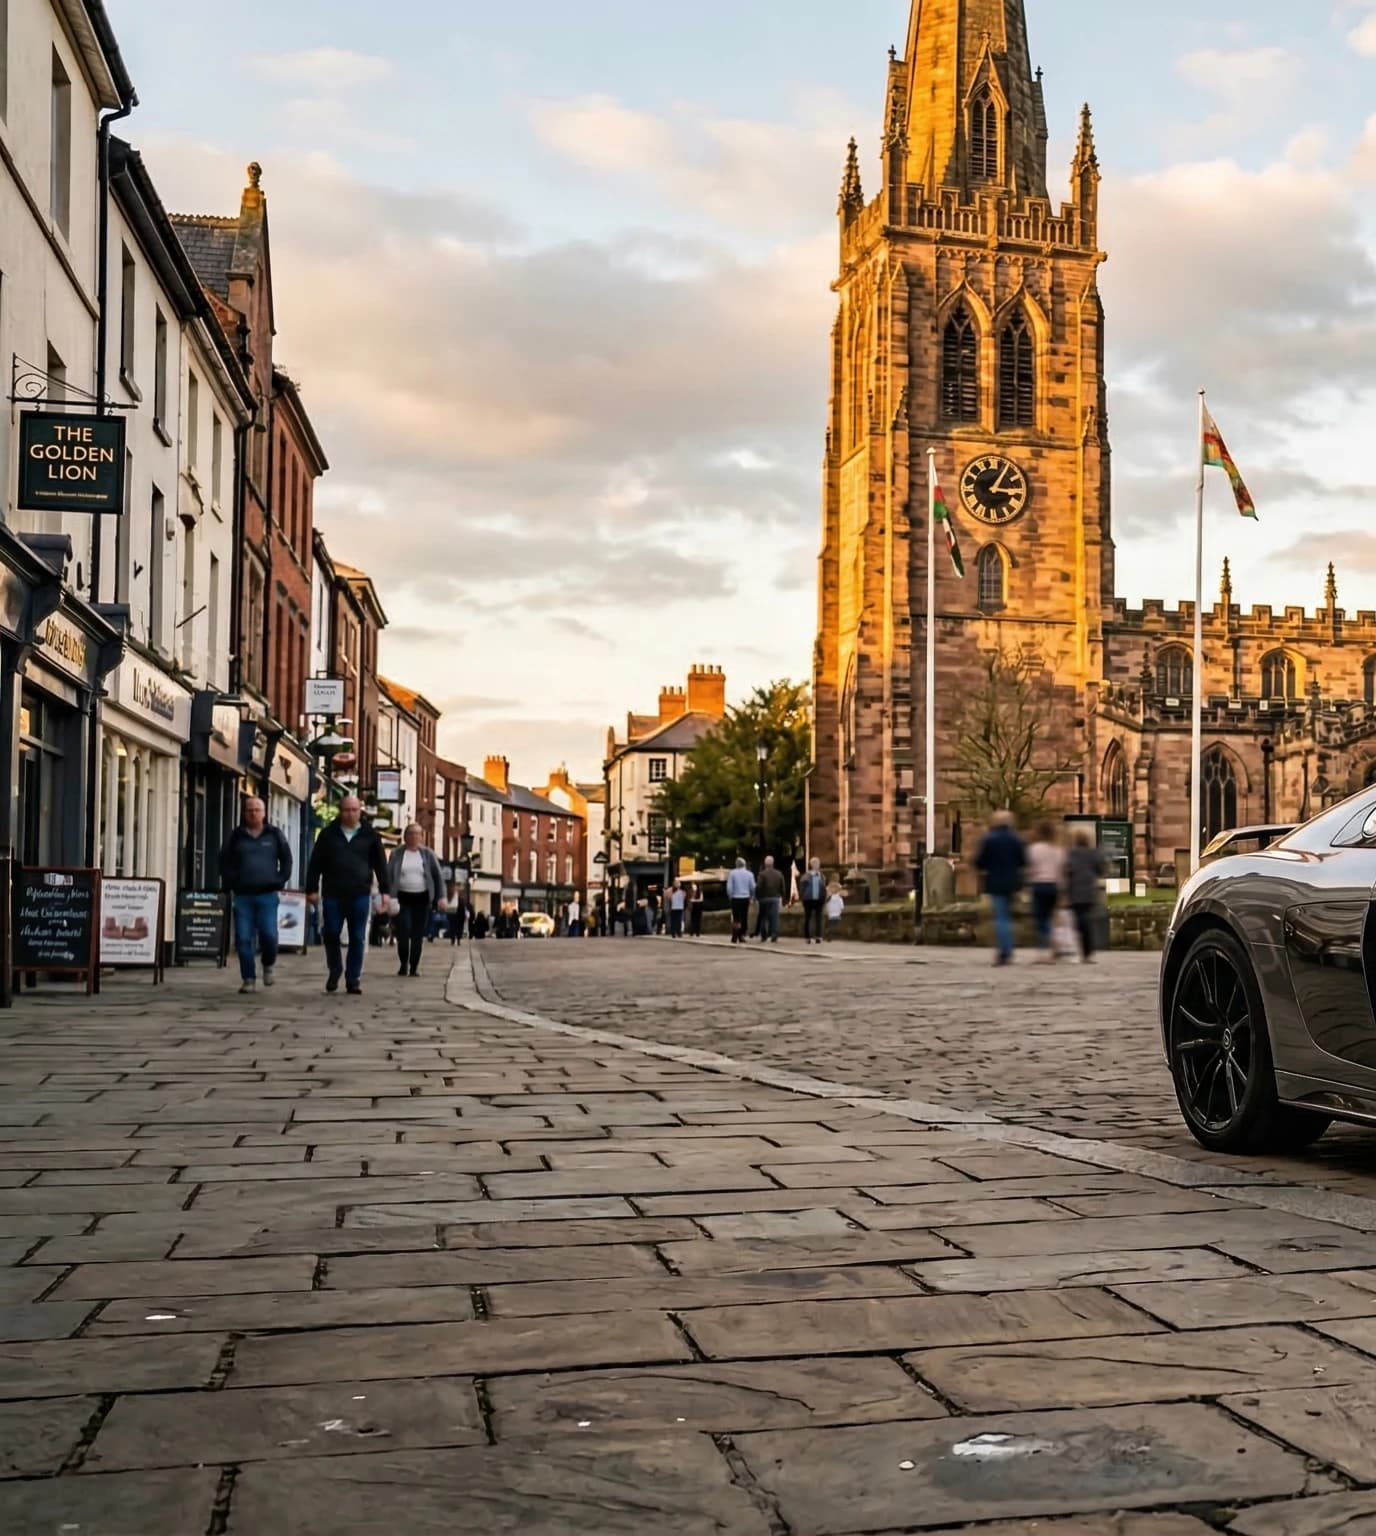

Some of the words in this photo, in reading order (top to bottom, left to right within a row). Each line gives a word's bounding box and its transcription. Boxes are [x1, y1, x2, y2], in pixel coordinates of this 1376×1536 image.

[53, 425, 93, 442] THE
[30, 444, 114, 463] GOLDEN
[48, 464, 97, 481] LION
